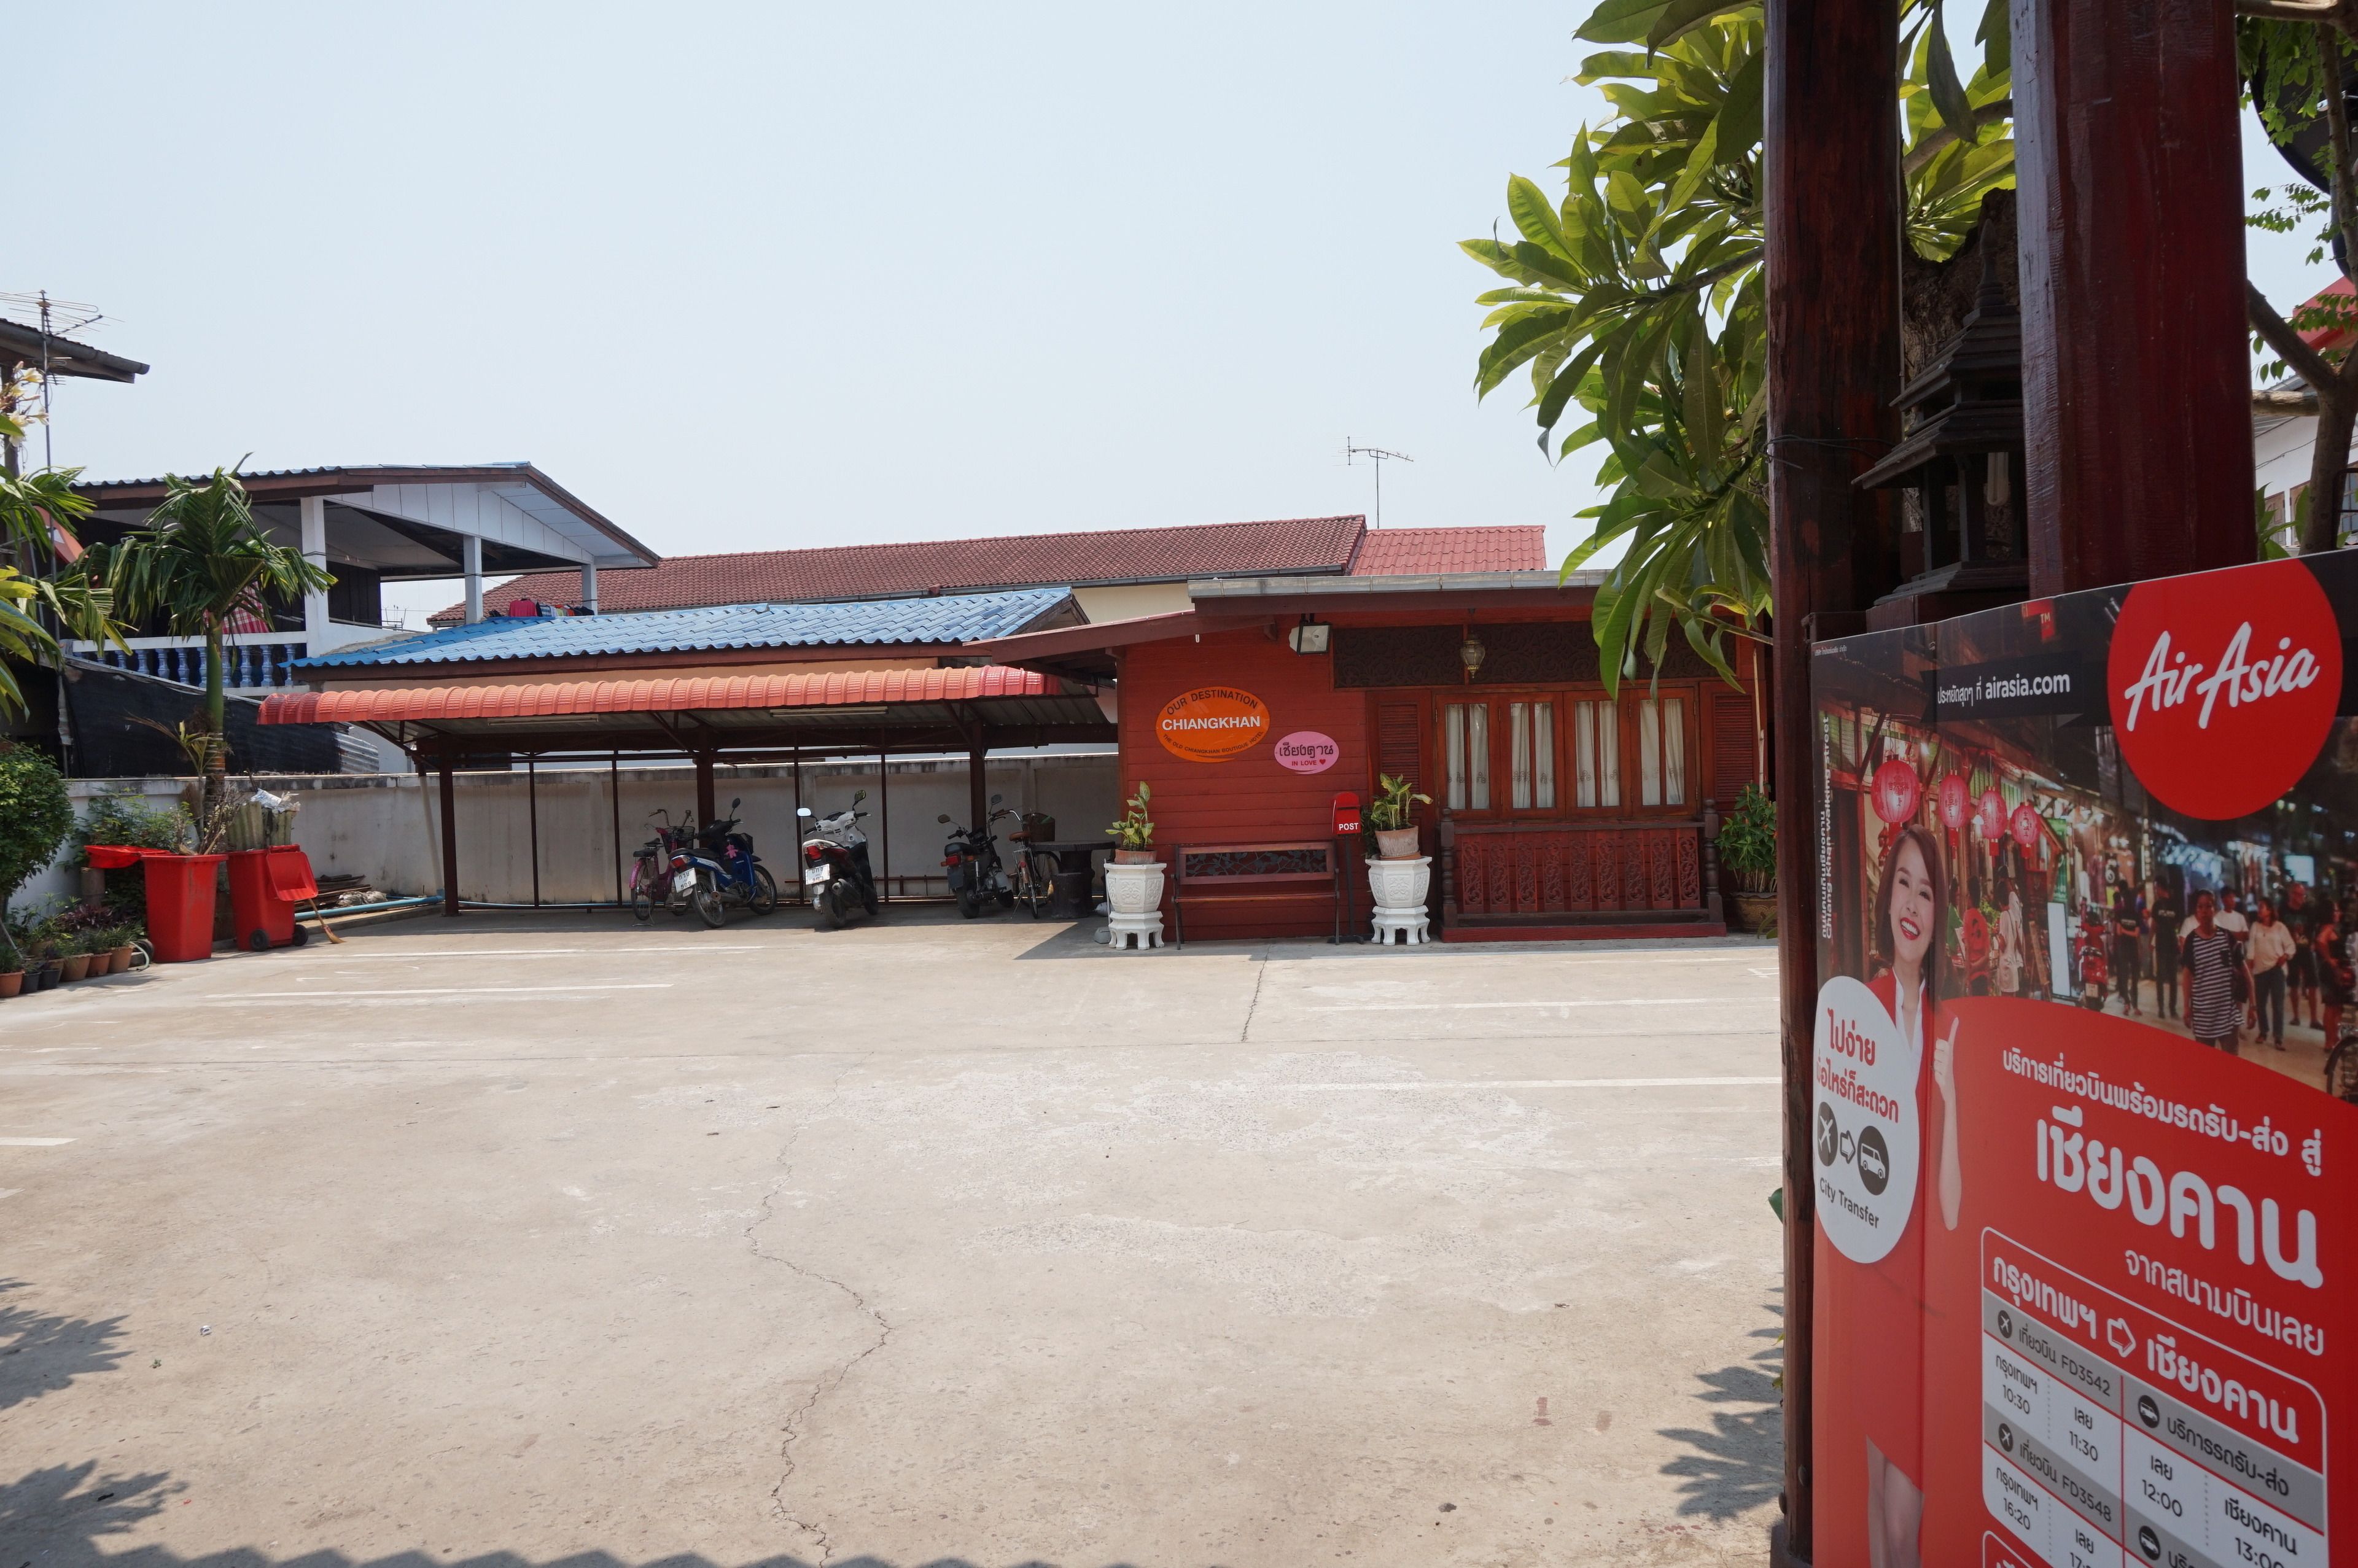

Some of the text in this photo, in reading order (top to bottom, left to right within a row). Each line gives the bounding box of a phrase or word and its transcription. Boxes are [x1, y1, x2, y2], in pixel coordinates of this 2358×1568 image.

[1167, 689, 1258, 715] OUR DESTINATION
[1985, 673, 2071, 700] airasia.com
[1161, 715, 1261, 731] CHIANGKHAN
[1172, 740, 1183, 750] OLD
[1221, 742, 1248, 753] BOUTIQUE
[1249, 731, 1264, 745] HOTEL
[1827, 1007, 1876, 1066] ไปง่าย
[2302, 1128, 2322, 1177] สู่
[1819, 1176, 1880, 1228] City Transfer
[2036, 1105, 2324, 1289] เชียงคาน
[2125, 1249, 2324, 1356] จากสนามบินเลย
[1993, 1256, 2299, 1444] กรุงเทพฯ เชียงคาน
[2019, 1324, 2111, 1397] เที่ยวบิน FD3542
[1995, 1354, 2038, 1395] กรุงเทพฯ
[2002, 1384, 2030, 1415] 10:30
[2074, 1407, 2093, 1430] เลย
[2069, 1430, 2098, 1461] 11:30
[2167, 1416, 2289, 1497] บริการรถรับ-ส่ง
[2020, 1440, 2112, 1523] เที่ยวบิน FD3548
[2150, 1454, 2173, 1481] เลย
[1996, 1467, 2039, 1512] กรุงเทพฯ
[2142, 1479, 2182, 1517] 12:00
[2003, 1497, 2030, 1531] 16:20
[2224, 1497, 2298, 1556] เชียงคาน
[2076, 1529, 2095, 1554] เลย
